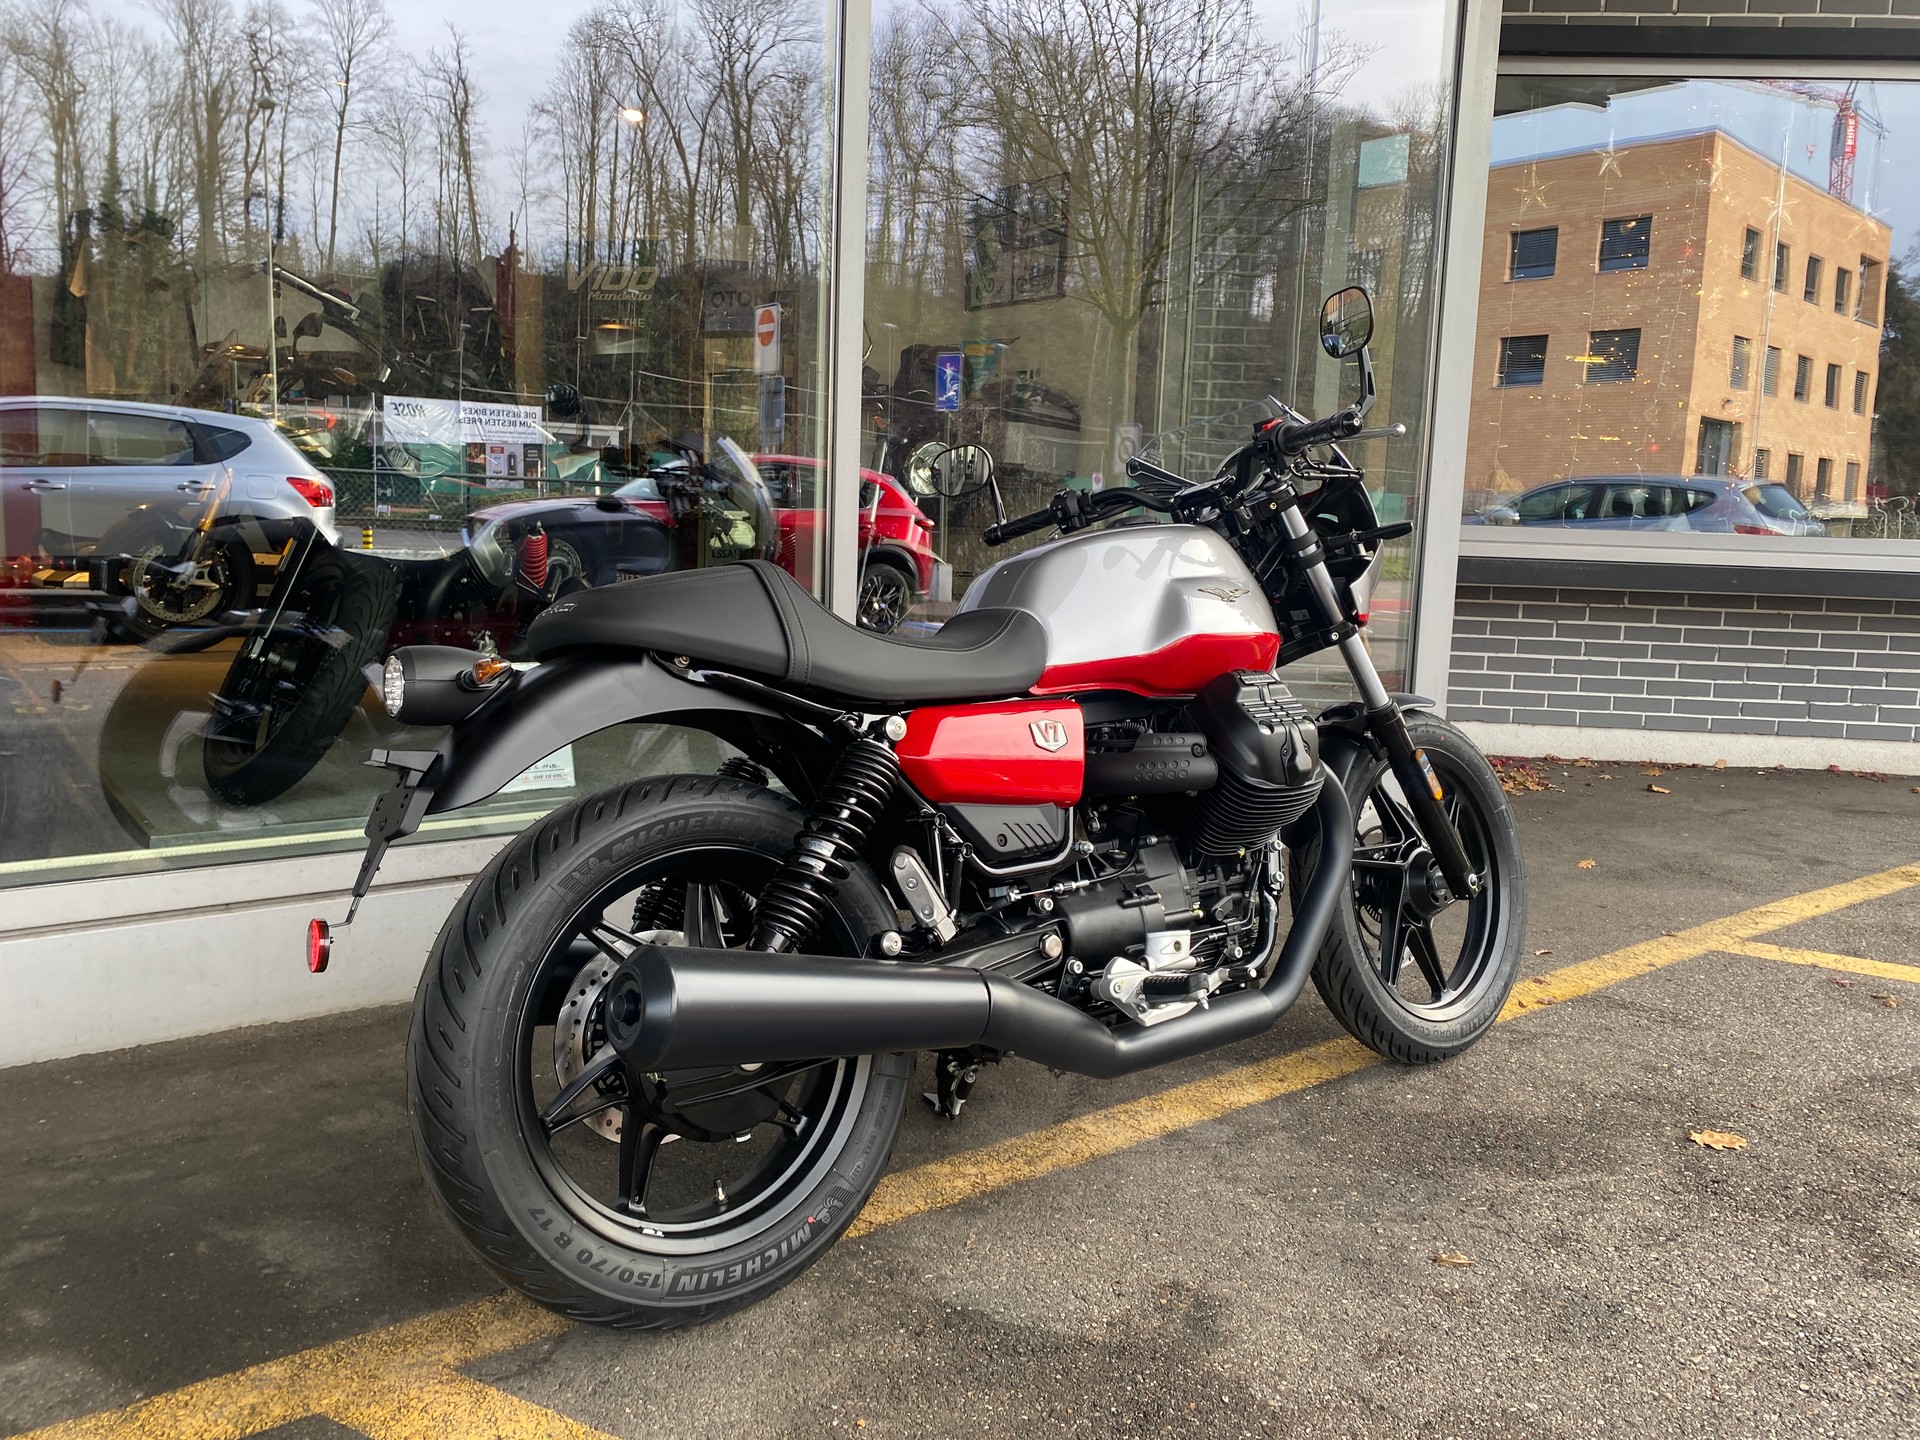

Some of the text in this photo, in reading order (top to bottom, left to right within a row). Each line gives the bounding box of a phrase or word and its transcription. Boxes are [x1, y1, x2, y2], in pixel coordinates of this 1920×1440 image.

[566, 260, 660, 291] V100
[1034, 722, 1060, 744] V7
[610, 812, 752, 862] MICHELIN
[1394, 1010, 1431, 1038] CLASSIC
[1432, 1028, 1458, 1040] ROAD
[527, 1207, 662, 1289] 150/70 B 17
[675, 1222, 812, 1292] MICHELIN
